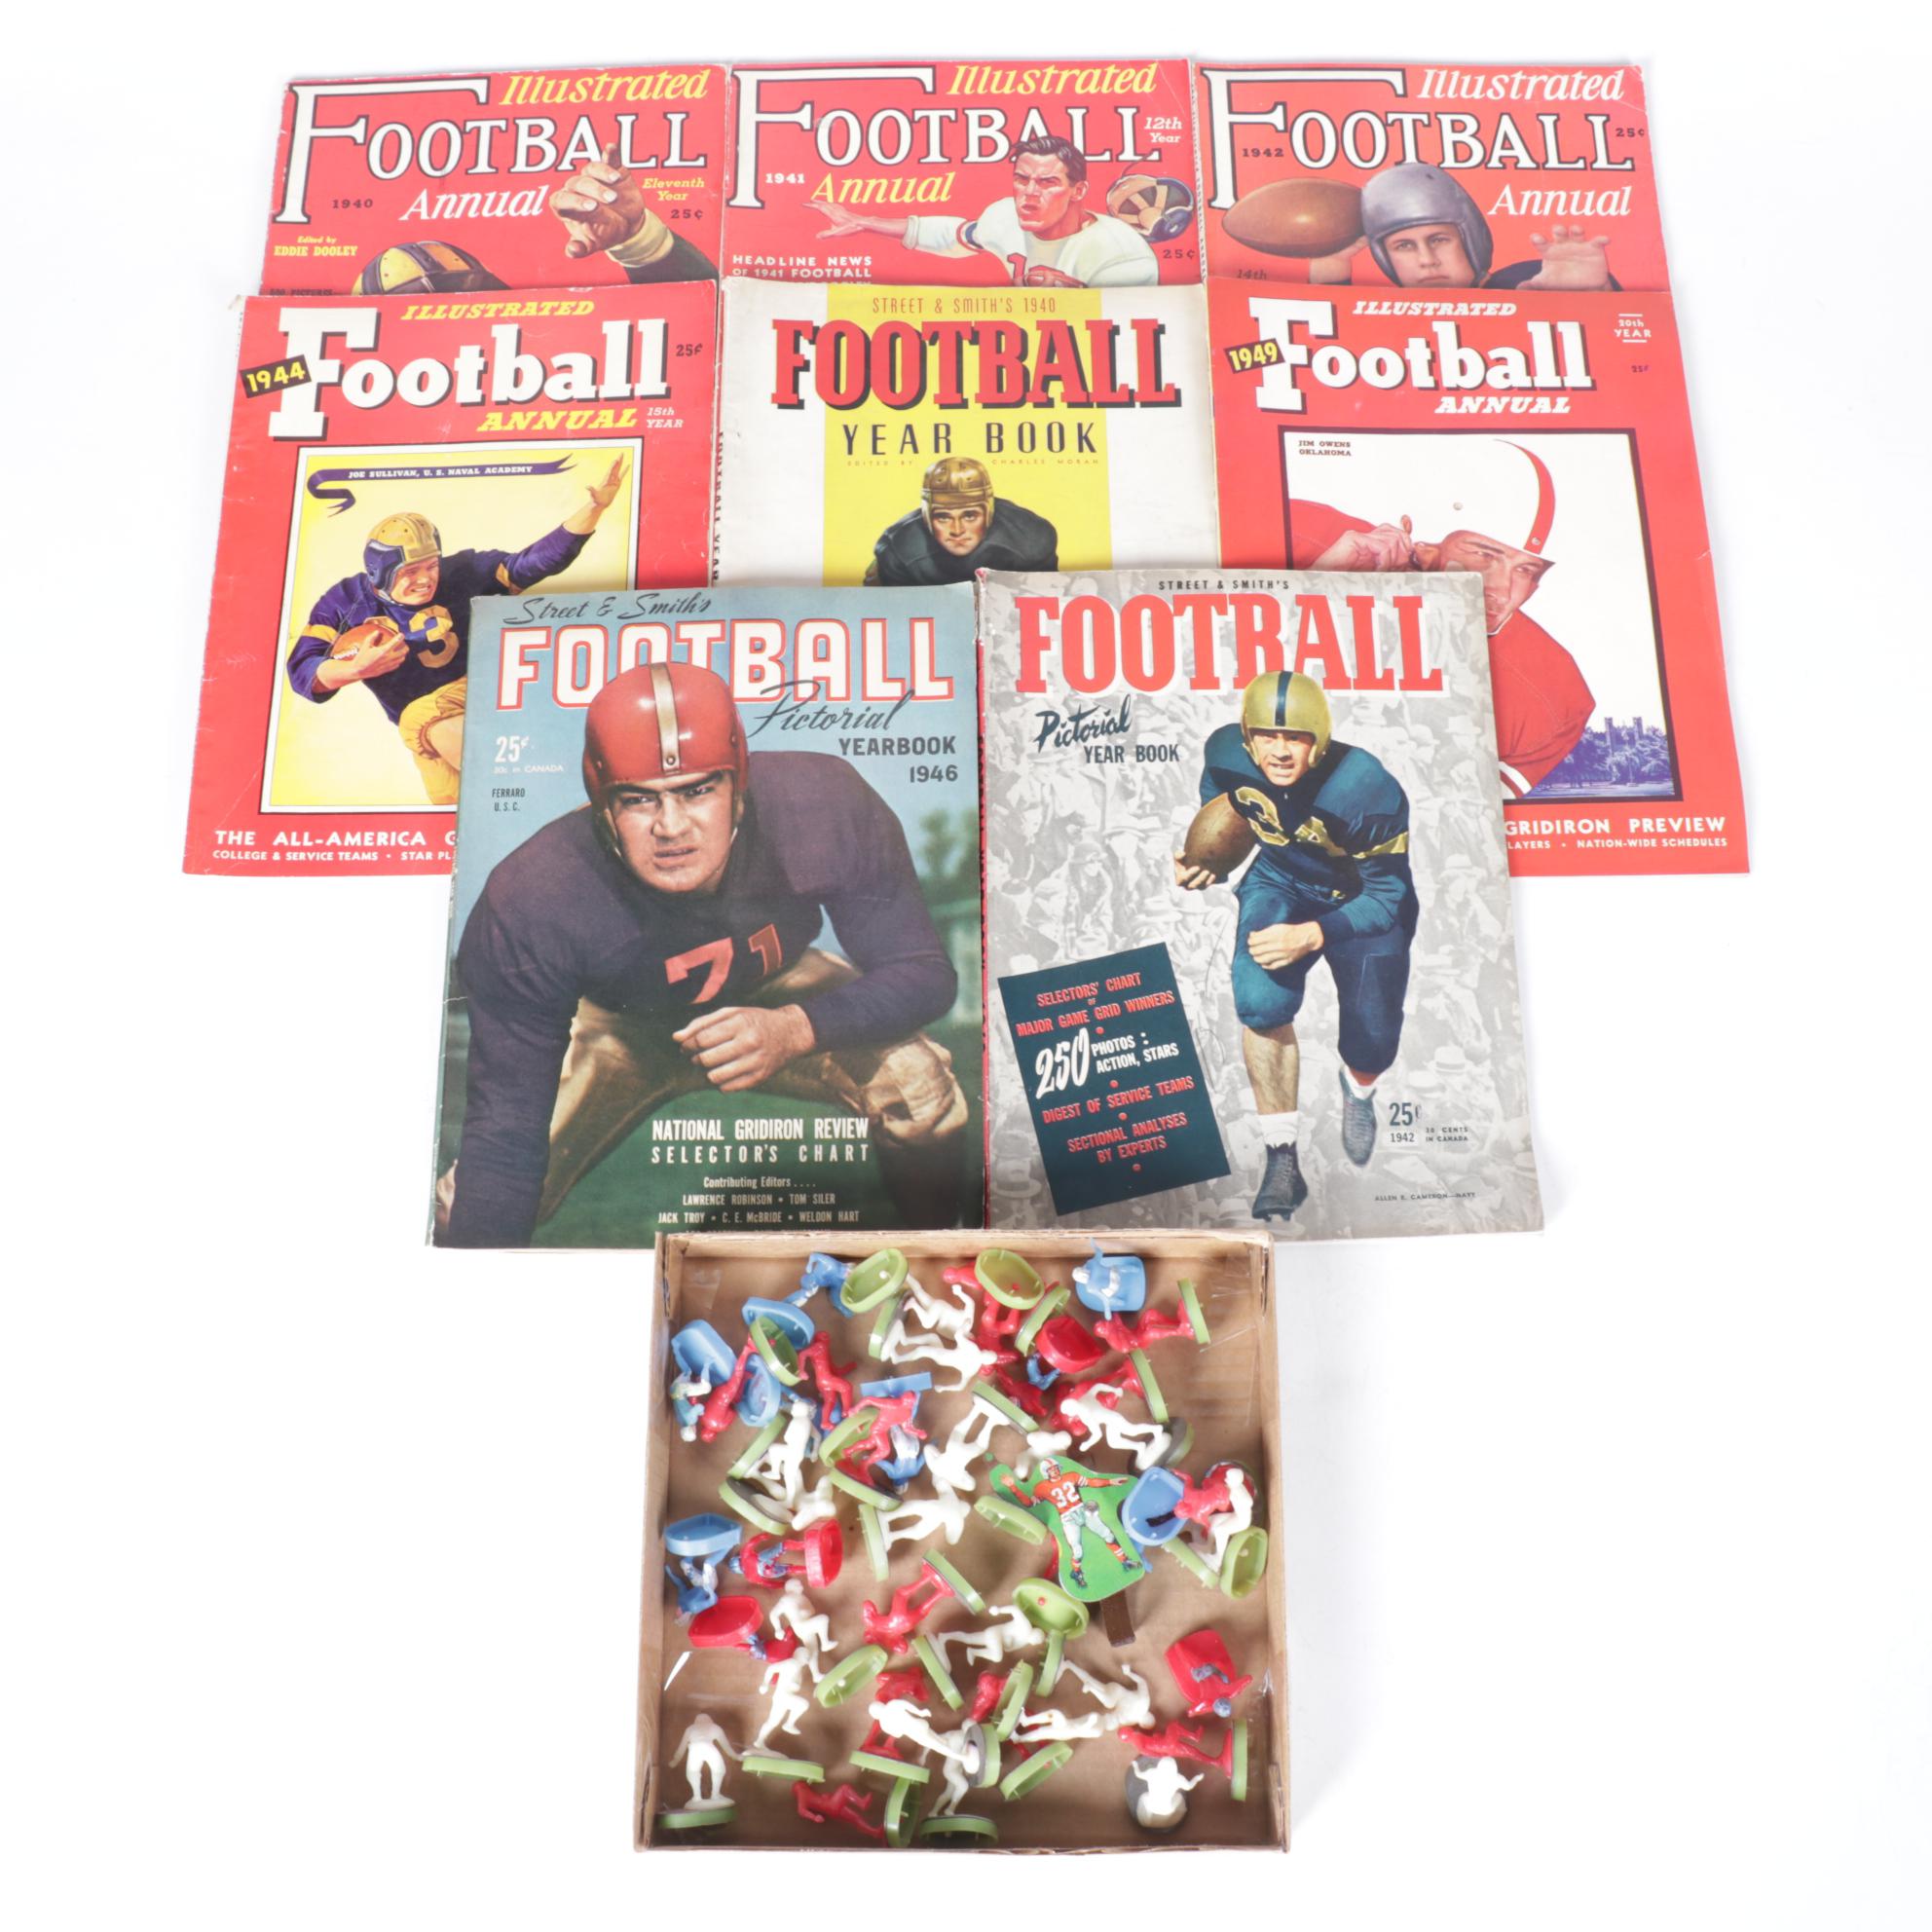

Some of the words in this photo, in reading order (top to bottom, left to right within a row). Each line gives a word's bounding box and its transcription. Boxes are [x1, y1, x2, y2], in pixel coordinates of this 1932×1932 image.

[499, 69, 711, 106] Illustrated
[947, 63, 1159, 96] Illustrated
[1418, 69, 1625, 101] Illustrated
[1144, 116, 1183, 130] 12th
[1615, 127, 1645, 138] 25¢
[1149, 132, 1181, 144] Year
[1201, 67, 1636, 211] FOOTBALL
[272, 76, 708, 225] FOOTBALL
[1242, 147, 1283, 158] 1942
[643, 177, 705, 189] Eleventh
[764, 171, 805, 185] 1941
[811, 172, 956, 204] Annual
[332, 198, 374, 208] 1940
[399, 185, 550, 222] Annual
[657, 190, 688, 202] Year
[1489, 184, 1631, 217] Annual
[671, 208, 704, 221] 25¢
[297, 236, 323, 244] Edited
[325, 235, 337, 245] by
[274, 245, 309, 257] EDDIE
[313, 245, 358, 257] DOOLEY
[732, 255, 816, 266] HEADLINE
[828, 256, 872, 266] NEWS
[1163, 249, 1196, 260] 25¢
[732, 268, 748, 277] OF
[755, 269, 784, 279] 1941
[791, 268, 872, 279] FOOTBALL
[1237, 269, 1267, 280] 14th
[400, 300, 596, 321] ILLUSTRATED
[873, 297, 924, 314] STREET
[934, 297, 943, 313] &
[953, 297, 1014, 313] SMITH'S
[1023, 296, 1057, 313] 1940
[1353, 301, 1517, 317] ILLUSTRATED
[1614, 328, 1652, 338] YEAR
[1618, 318, 1645, 328] 20th
[676, 343, 703, 357] 25¢
[1229, 342, 1279, 372] 1949
[1248, 297, 1598, 416] Football
[770, 318, 1183, 410] FOOTBALL
[245, 361, 307, 393] 1944
[268, 307, 672, 442] Football
[647, 406, 675, 417] 15th
[1434, 396, 1571, 415] ANNUAL
[476, 407, 639, 433] ANNUAL
[646, 418, 684, 428] YEAR
[842, 423, 952, 456] YEAR
[985, 421, 1097, 454] BOOK
[1298, 448, 1352, 457] OKLAHOMA
[348, 470, 365, 479] JOE
[369, 469, 421, 479] SULLIVAN,
[423, 468, 433, 477] U.
[435, 467, 445, 476] S.
[448, 466, 480, 476] NAVAL
[484, 465, 534, 475] ACADEMY
[1158, 580, 1208, 590] STREET
[1217, 580, 1224, 589] &
[1232, 579, 1290, 590] SMITH'S
[502, 596, 586, 626] Street
[597, 597, 614, 617] &
[616, 592, 712, 620] Smith's
[1015, 593, 1445, 693] FOOTBALL
[496, 615, 956, 712] FOOTBALL
[747, 679, 915, 739] Pictorial
[1033, 693, 1133, 755] Pictorial
[495, 735, 529, 762] 25¢
[838, 735, 957, 757] YEARBOOK
[1084, 746, 1125, 764] YEAR
[1135, 743, 1180, 762] BOOK
[525, 764, 564, 773] CANADA
[909, 763, 958, 784] 1946
[492, 787, 526, 799] FERRARO
[1505, 819, 1611, 836] GRIDIRON
[1628, 816, 1726, 834] PREVIEW
[215, 831, 256, 845] THE
[273, 831, 427, 846] ALL-AMERICA
[1507, 840, 1551, 849] LAYERS
[1577, 838, 1657, 849] NATION-WIDE
[1661, 836, 1728, 848] SCHEDULES
[212, 850, 268, 862] COLLEGE
[272, 851, 281, 861] &
[285, 851, 334, 861] SERVICE
[338, 851, 379, 861] TEAMS
[401, 850, 433, 861] STAR
[664, 922, 782, 1005] 71
[1036, 982, 1100, 1008] SELECTORS'
[1106, 972, 1141, 992] CHART
[1088, 997, 1096, 1006] OF
[1016, 1017, 1054, 1037] MAJOR
[1058, 1011, 1090, 1029] GAME
[1094, 1003, 1121, 1021] GRID
[1125, 990, 1175, 1013] WINNERS
[1091, 1035, 1135, 1057] PHOTOS
[1035, 1027, 1090, 1099] 250
[1096, 1053, 1140, 1074] ACTION,
[1143, 1043, 1179, 1062] STARS
[1042, 1103, 1081, 1125] DIGEST
[1087, 1098, 1101, 1114] OF
[1106, 1086, 1152, 1109] SERVICE
[1155, 1075, 1195, 1096] TEAMS
[652, 1119, 724, 1141] NATIONAL
[734, 1119, 804, 1140] GRIDIRON
[814, 1117, 870, 1139] REVIEW
[1067, 1127, 1128, 1154] SECTIONAL
[1132, 1112, 1188, 1136] ANALYSES
[1391, 1133, 1415, 1142] 1942
[650, 1143, 779, 1165] SELECTOR'S
[799, 1143, 870, 1163] CHART
[1096, 1149, 1113, 1164] BY
[1118, 1135, 1168, 1158] EXPERTS
[703, 1176, 758, 1189] Contributing
[683, 1194, 725, 1207] LAWRENCE
[731, 1193, 773, 1206] ROBINSON
[789, 1193, 807, 1205] TOM
[812, 1193, 836, 1205] SILER
[658, 1211, 679, 1224] JACK
[684, 1211, 705, 1223] TROY
[722, 1211, 731, 1223] C.
[734, 1211, 744, 1223] E.
[746, 1210, 783, 1223] McBRIDE
[799, 1210, 833, 1223] WELDON
[837, 1209, 860, 1222] HART
[1051, 1480, 1080, 1508] 32
